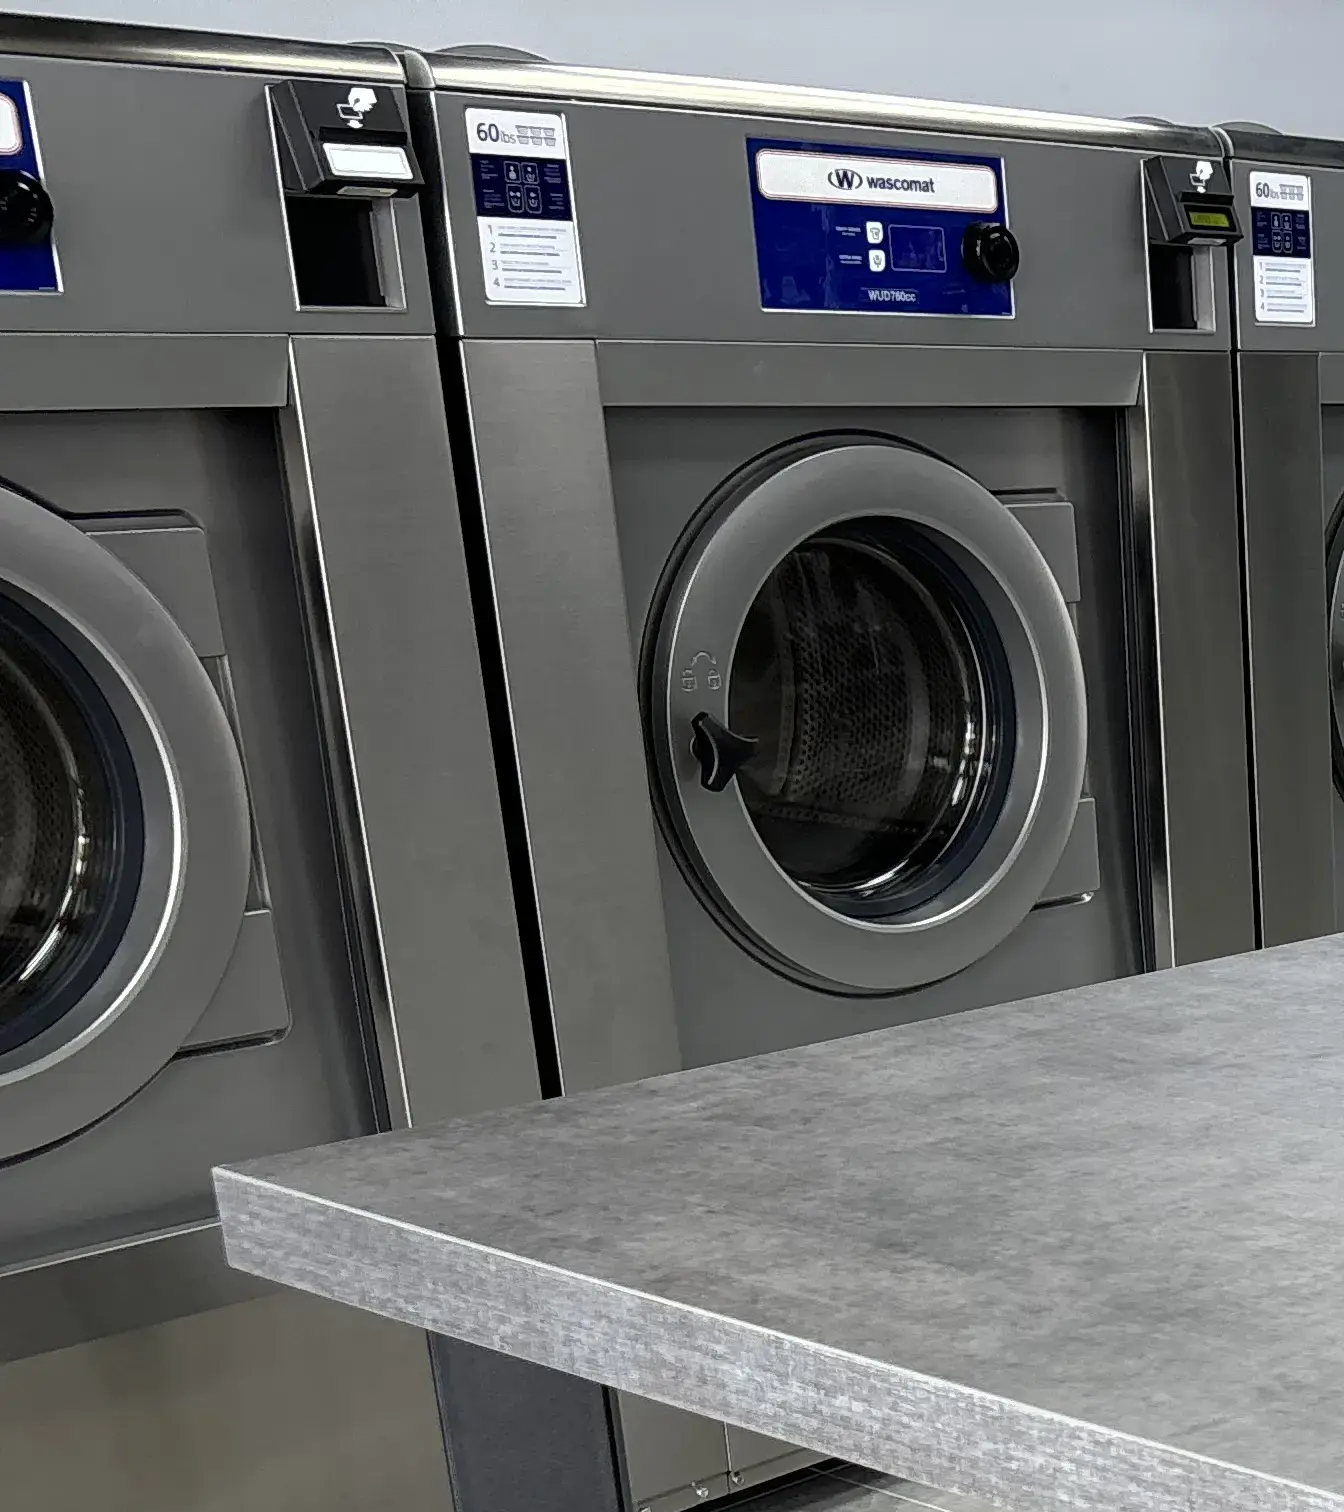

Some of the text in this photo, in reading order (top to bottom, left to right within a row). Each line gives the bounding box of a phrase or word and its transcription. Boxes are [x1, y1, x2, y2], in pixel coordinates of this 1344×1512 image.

[866, 175, 935, 193] wascomat
[489, 242, 496, 253] 2
[491, 260, 498, 270] 3
[493, 277, 500, 287] 4
